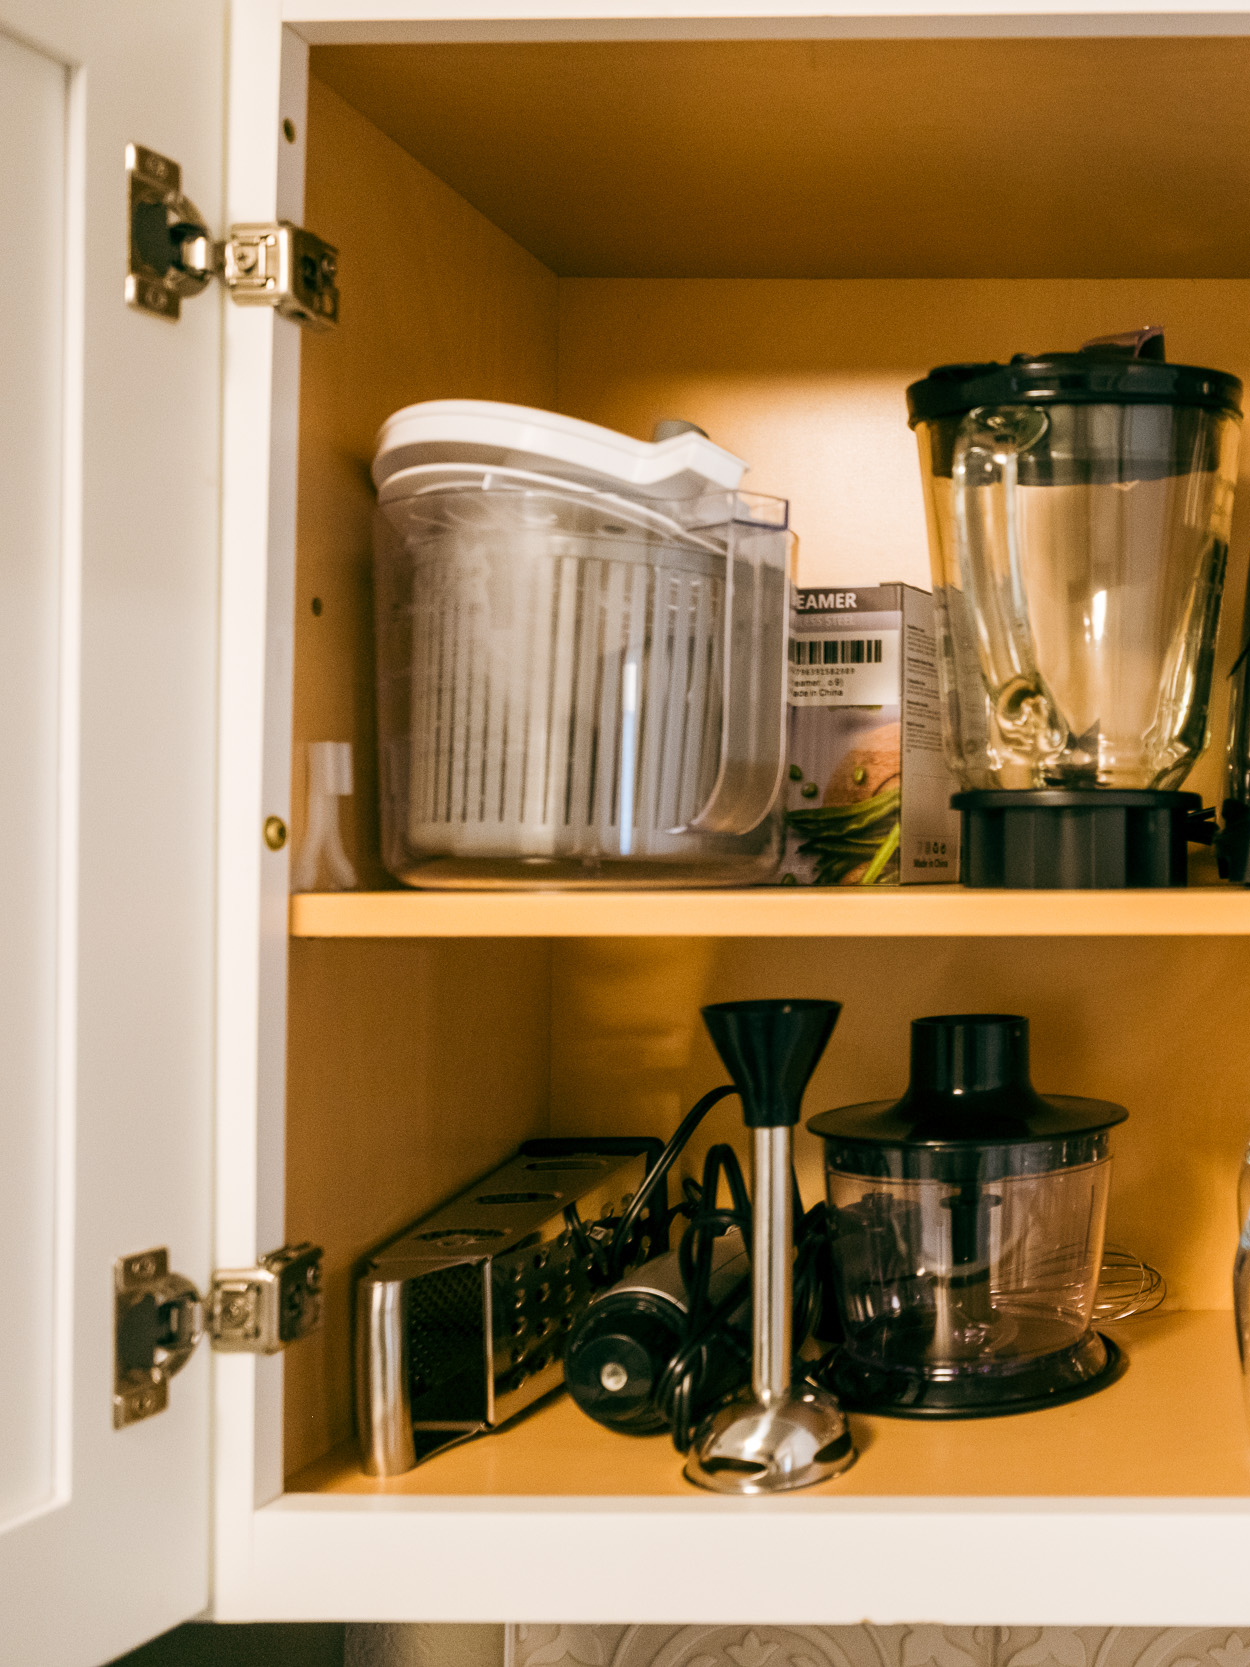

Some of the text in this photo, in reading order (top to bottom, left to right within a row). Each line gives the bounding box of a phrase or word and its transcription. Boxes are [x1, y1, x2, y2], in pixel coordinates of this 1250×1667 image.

[797, 592, 857, 610] EAMER
[792, 689, 808, 698] ade
[819, 688, 843, 697] China
